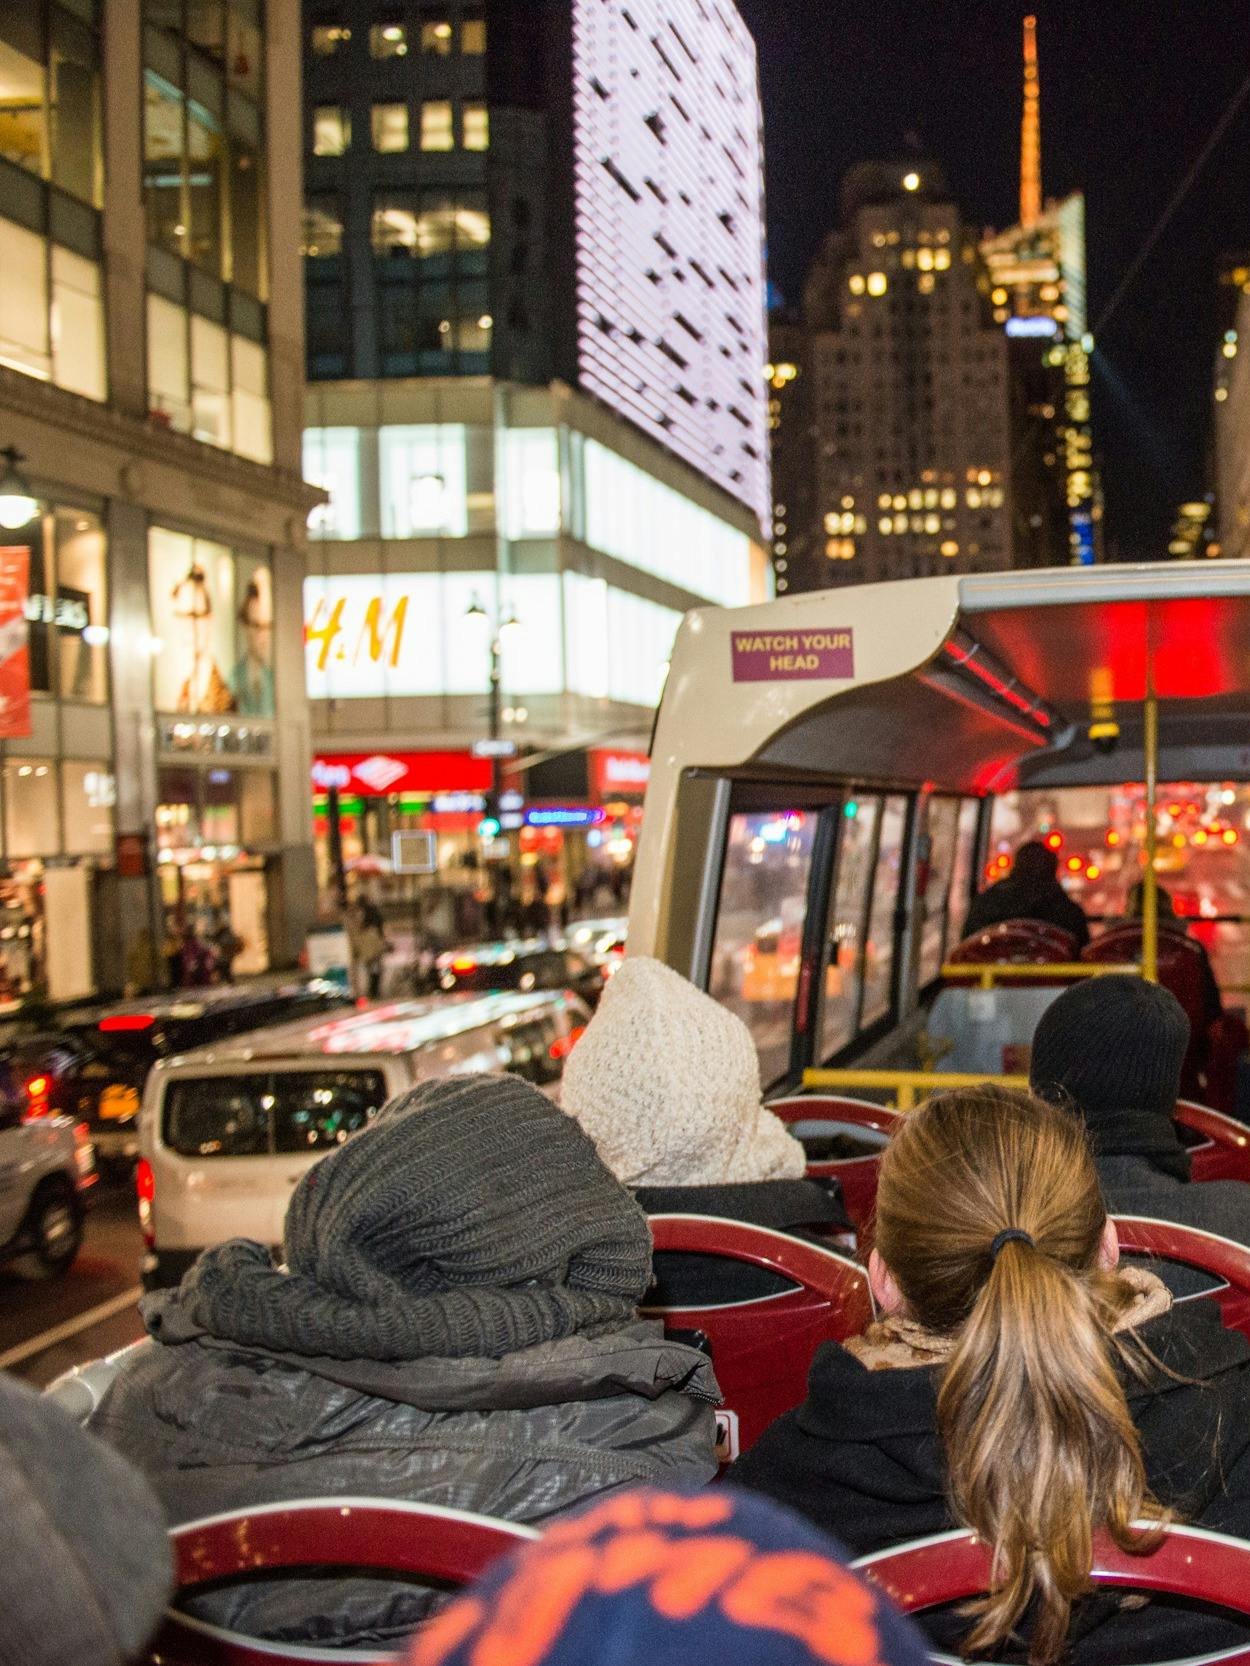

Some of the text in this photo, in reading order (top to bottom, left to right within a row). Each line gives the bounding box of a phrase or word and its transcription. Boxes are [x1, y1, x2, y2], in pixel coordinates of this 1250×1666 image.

[736, 633, 850, 653] WATCH YOUR
[769, 654, 820, 672] HEAD
